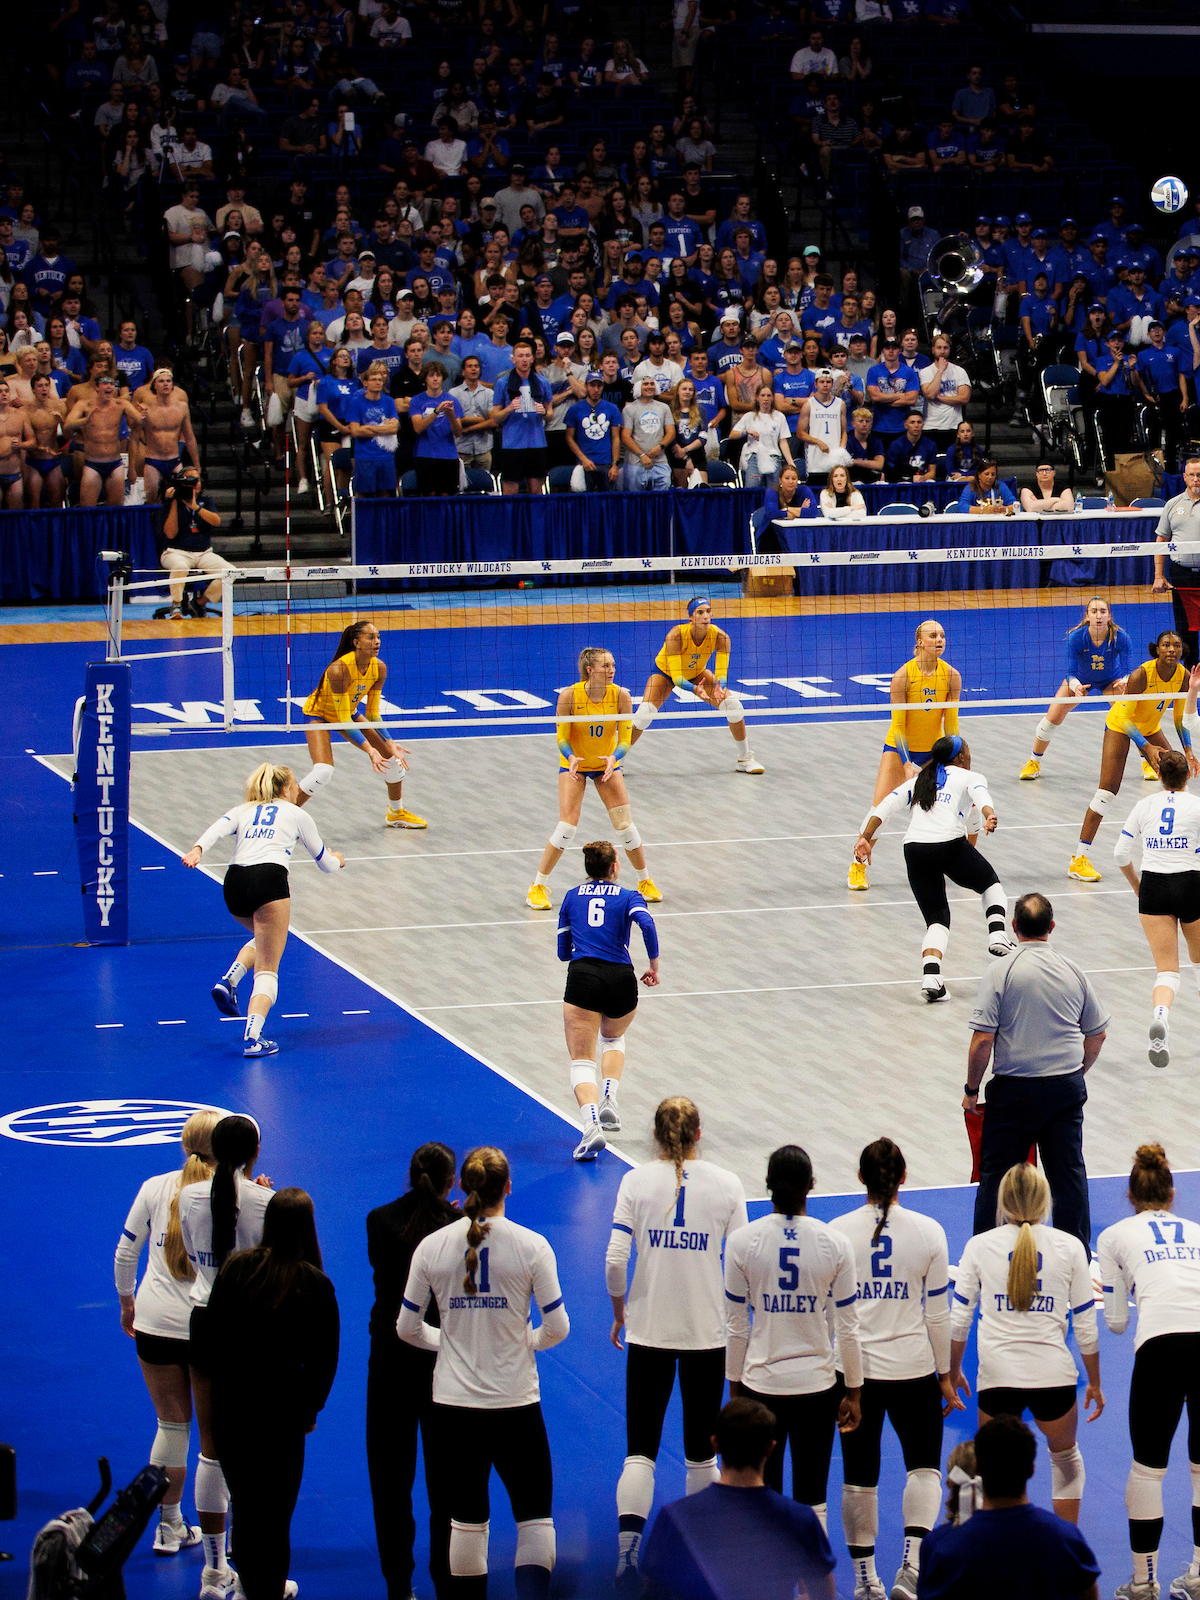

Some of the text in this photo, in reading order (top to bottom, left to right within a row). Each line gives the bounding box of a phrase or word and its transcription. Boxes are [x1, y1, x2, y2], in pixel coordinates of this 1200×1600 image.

[678, 233, 688, 258] 1
[718, 353, 746, 368] KENTUCK
[825, 421, 830, 434] 1
[946, 547, 1044, 559] KENTUCKY WILDCATS
[681, 554, 781, 567] KENTUCKY WILDCATS
[409, 562, 512, 575] KENTUCKY WILDCATS
[688, 660, 697, 669] 2
[1091, 662, 1105, 671] 12
[923, 687, 937, 696] Pitt
[1156, 700, 1166, 713] 4
[589, 725, 604, 738] 10
[96, 683, 116, 926] KENTUCKY
[252, 804, 279, 826] 13
[1159, 807, 1176, 835] 9
[244, 827, 276, 839] LAMB
[1145, 837, 1189, 849] WALKER
[577, 883, 622, 896] BEAVIN
[587, 897, 606, 928] 6
[673, 1186, 685, 1227] 1
[783, 1227, 799, 1241] UK
[1147, 1220, 1186, 1245] 17
[648, 1229, 709, 1251] WILSON
[870, 1235, 892, 1278] 2
[777, 1247, 801, 1291] 5
[448, 1296, 509, 1310] GOETZINGER
[762, 1293, 818, 1314] DAILEY
